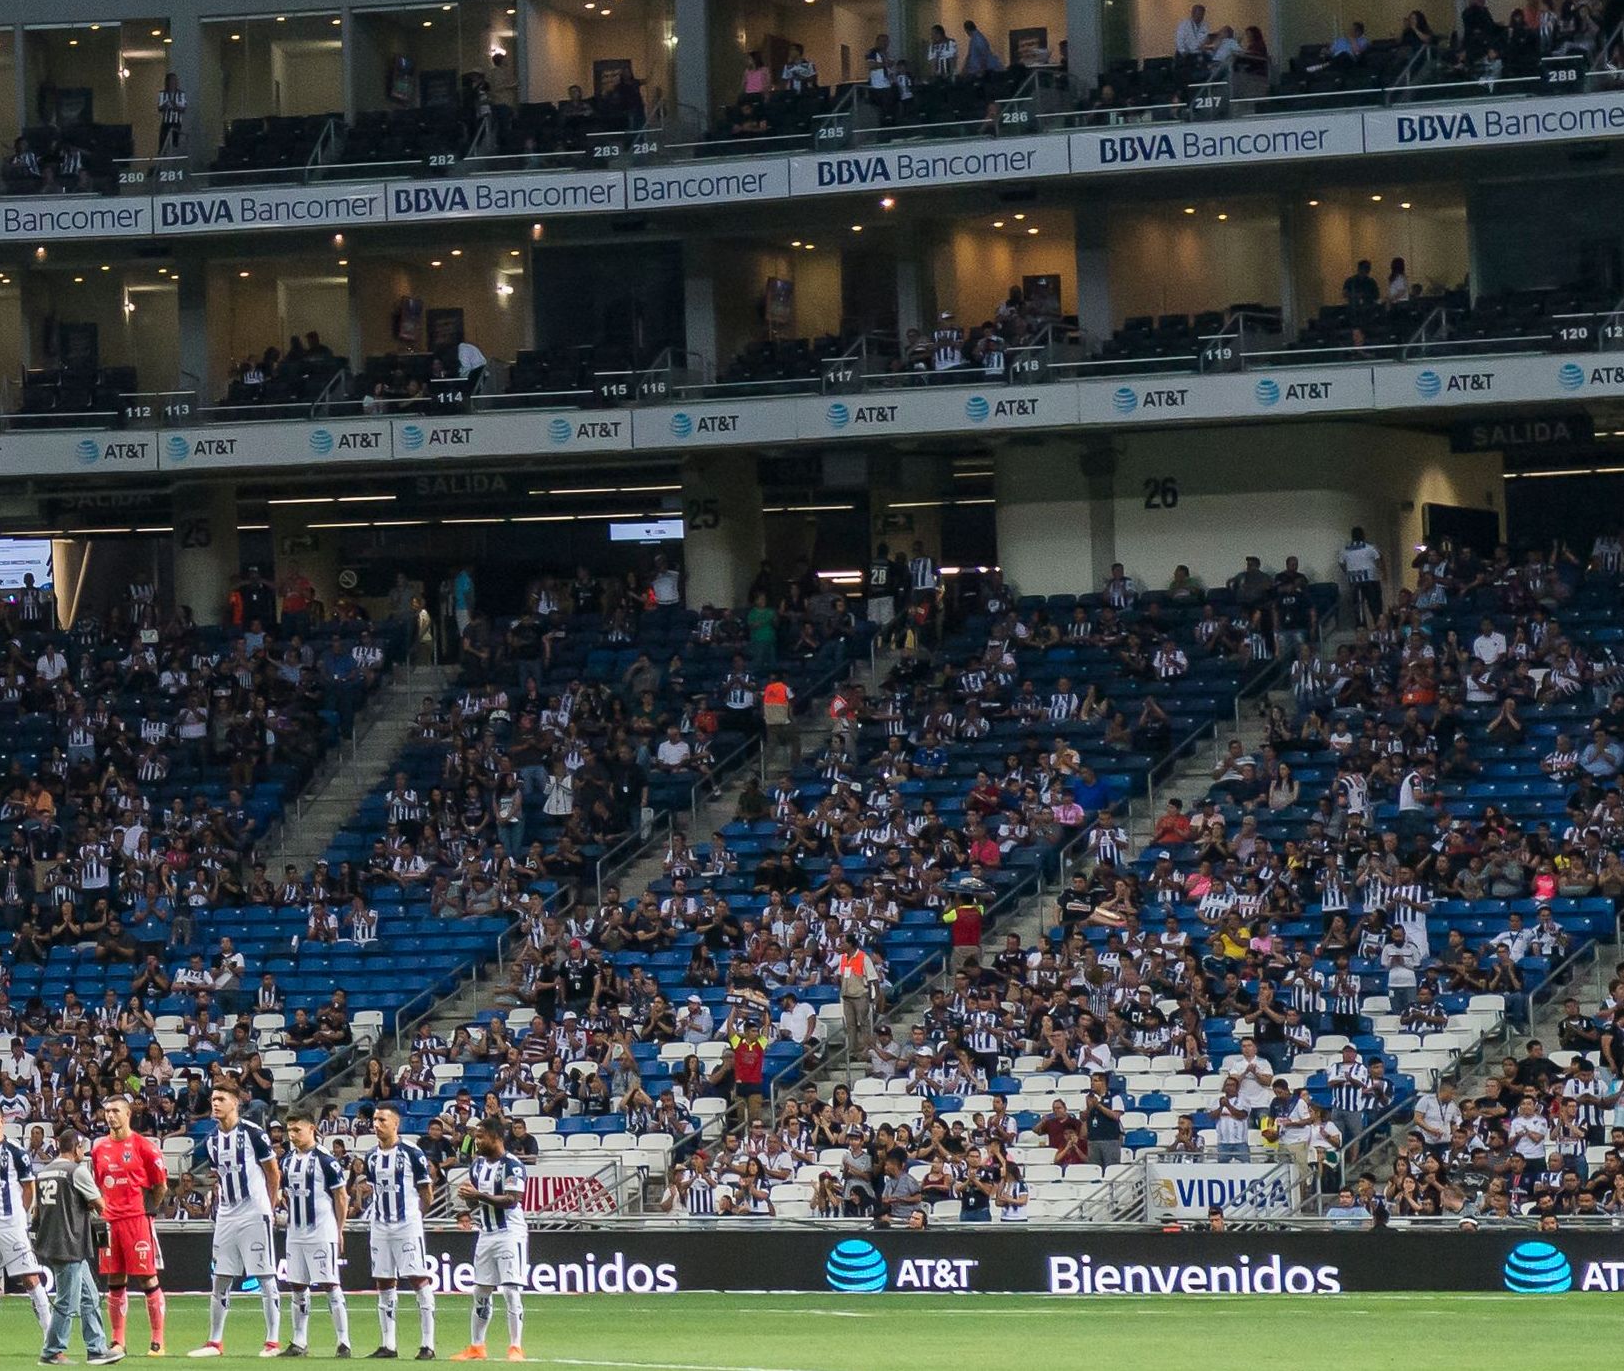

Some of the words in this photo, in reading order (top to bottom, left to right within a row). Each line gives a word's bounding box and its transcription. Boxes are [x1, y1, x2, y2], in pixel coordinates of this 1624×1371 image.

[1549, 70, 1576, 82] 288
[1003, 112, 1027, 123] 286
[594, 146, 620, 157] 283
[1100, 135, 1176, 163] BBVA
[1184, 130, 1330, 160] Bancomer
[818, 158, 890, 186] BBVA
[896, 145, 1037, 180] Bancomer
[119, 172, 144, 183] 280
[631, 168, 769, 203] Bancomer
[162, 200, 233, 226] BBVA
[238, 189, 377, 221] Bancomer
[395, 187, 469, 213] BBVA
[476, 185, 616, 209] Bancomer
[1561, 328, 1587, 340] 120
[828, 371, 852, 382] 117
[602, 384, 626, 396] 115
[166, 405, 189, 415] 113
[577, 422, 621, 438] AT&T
[698, 416, 739, 432] AT&T
[1473, 422, 1570, 446] SALIDA
[429, 428, 473, 444] AT&T
[194, 439, 236, 455] AT&T
[416, 474, 507, 495] SALIDA
[1144, 478, 1178, 509] 26
[39, 1180, 57, 1205] 32
[1177, 1178, 1290, 1209] VIDUSA
[425, 1252, 678, 1293] Bievenidos
[897, 1259, 975, 1289] AT&T
[1049, 1253, 1341, 1294] Bienvenidos
